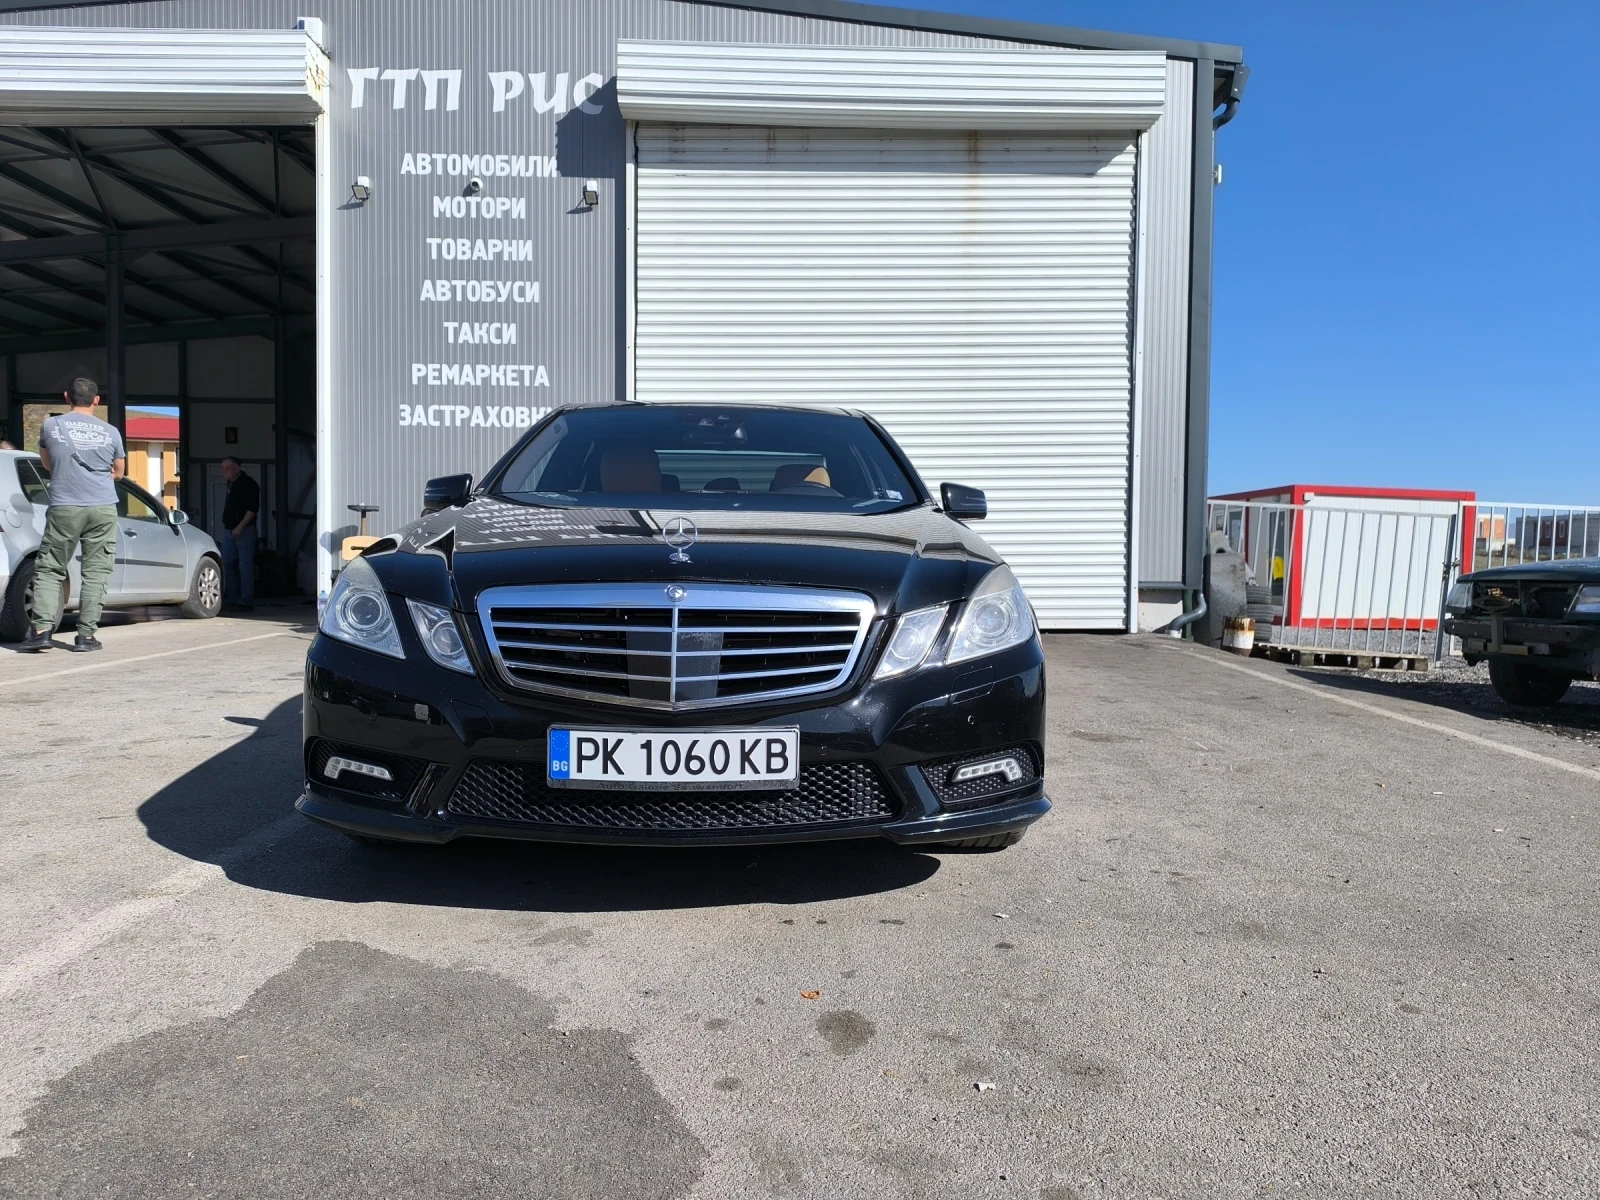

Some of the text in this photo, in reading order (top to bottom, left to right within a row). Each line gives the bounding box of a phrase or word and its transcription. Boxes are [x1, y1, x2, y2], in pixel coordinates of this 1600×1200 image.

[347, 67, 604, 115] ГТП РИС
[400, 153, 557, 178] АВТОМОБИЛИ
[433, 196, 526, 219] МОТОРИ
[426, 237, 533, 261] ТОВАРНИ
[420, 279, 540, 303] АВТОБУСИ
[443, 321, 516, 345] ТАКСИ
[411, 363, 550, 387] РЕМАРКЕТА
[399, 404, 552, 428] ЗАСТРАХОВК
[552, 760, 568, 772] BG
[576, 736, 789, 776] PK 1060 KB
